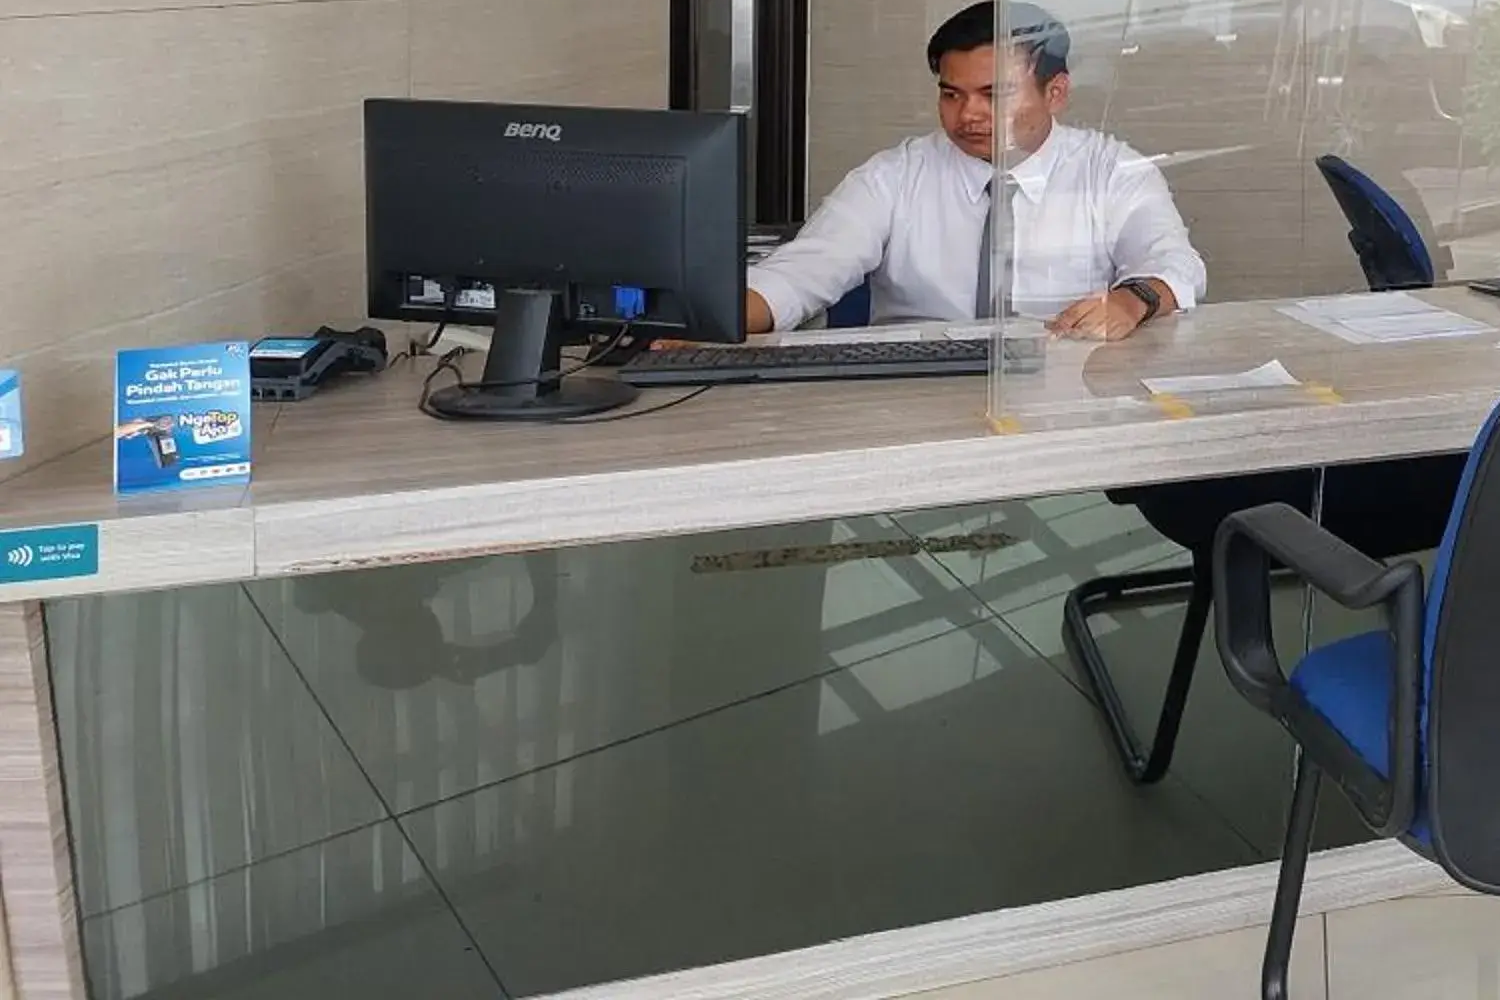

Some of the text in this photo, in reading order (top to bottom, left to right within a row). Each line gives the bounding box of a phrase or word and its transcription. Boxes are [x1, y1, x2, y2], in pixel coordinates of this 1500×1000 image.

[144, 365, 223, 381] Gak Perlu
[126, 379, 240, 397] Pindah Tangan
